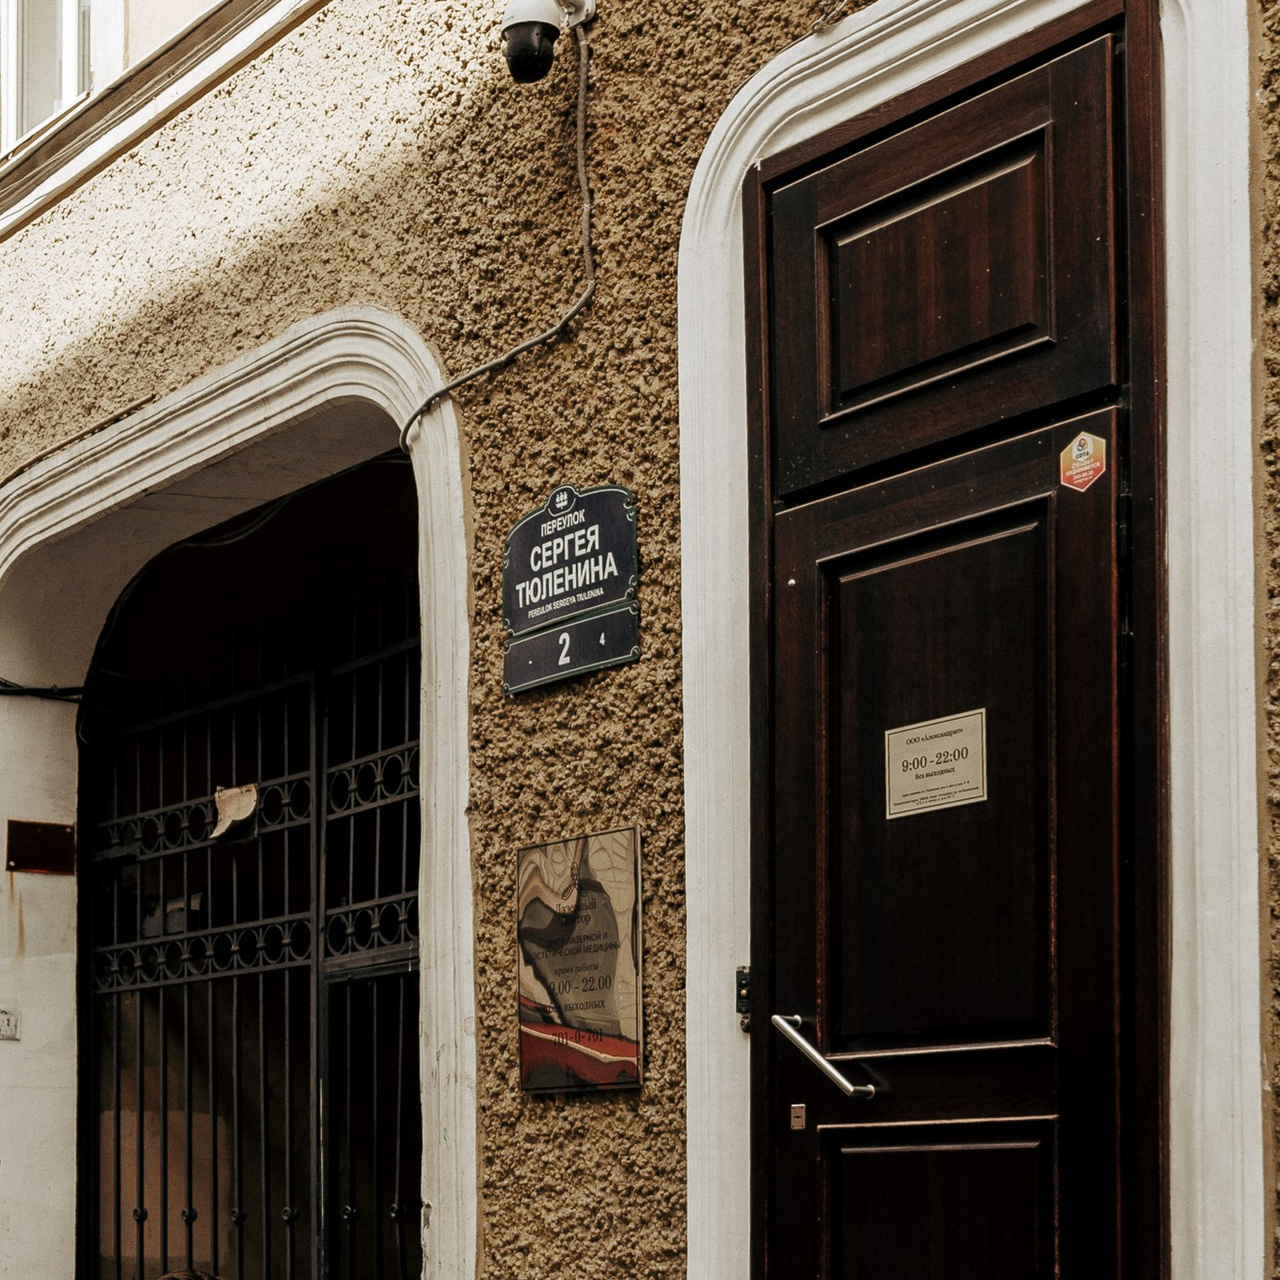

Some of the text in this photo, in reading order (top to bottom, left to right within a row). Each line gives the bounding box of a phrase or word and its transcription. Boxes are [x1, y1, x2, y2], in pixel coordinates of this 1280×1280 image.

[540, 508, 586, 537] ПЕРЕУЛОК
[530, 524, 600, 572] СЕРГЕЯ
[515, 551, 619, 608] ТЮЛЕНИНА
[558, 631, 606, 666] 2 4
[901, 755, 928, 772] 9:00
[935, 746, 969, 765] 22:00
[555, 898, 597, 914] Лазеный
[574, 962, 599, 974] работы
[581, 974, 612, 992] 22.00
[563, 999, 606, 1012] выходных
[552, 1027, 604, 1046] 701-0-701
